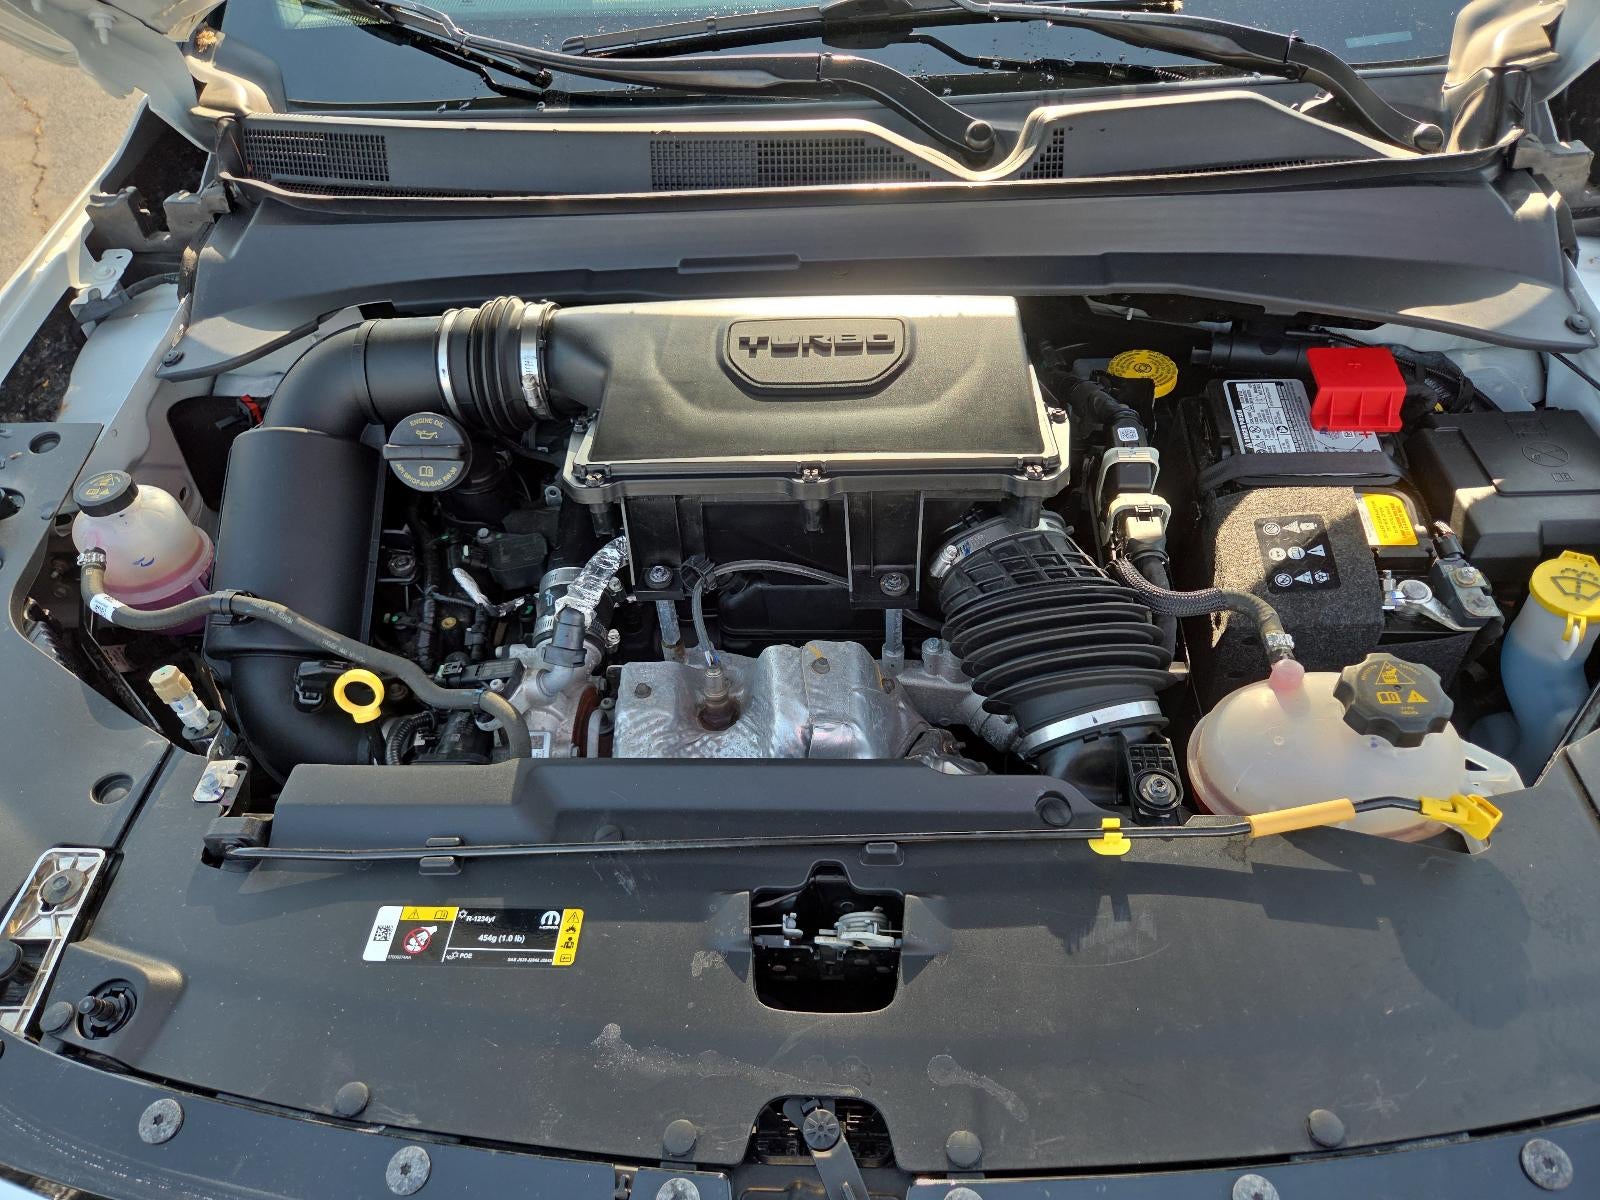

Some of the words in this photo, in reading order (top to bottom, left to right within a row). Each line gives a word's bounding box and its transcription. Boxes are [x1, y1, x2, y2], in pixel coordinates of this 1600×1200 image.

[738, 334, 896, 358] TURBO
[409, 417, 433, 427] ENGINE
[434, 419, 444, 429] OIL
[466, 915, 496, 924] R-1234yf
[478, 934, 497, 944] 454g
[498, 934, 513, 944] (1.0
[514, 934, 526, 944] lb)
